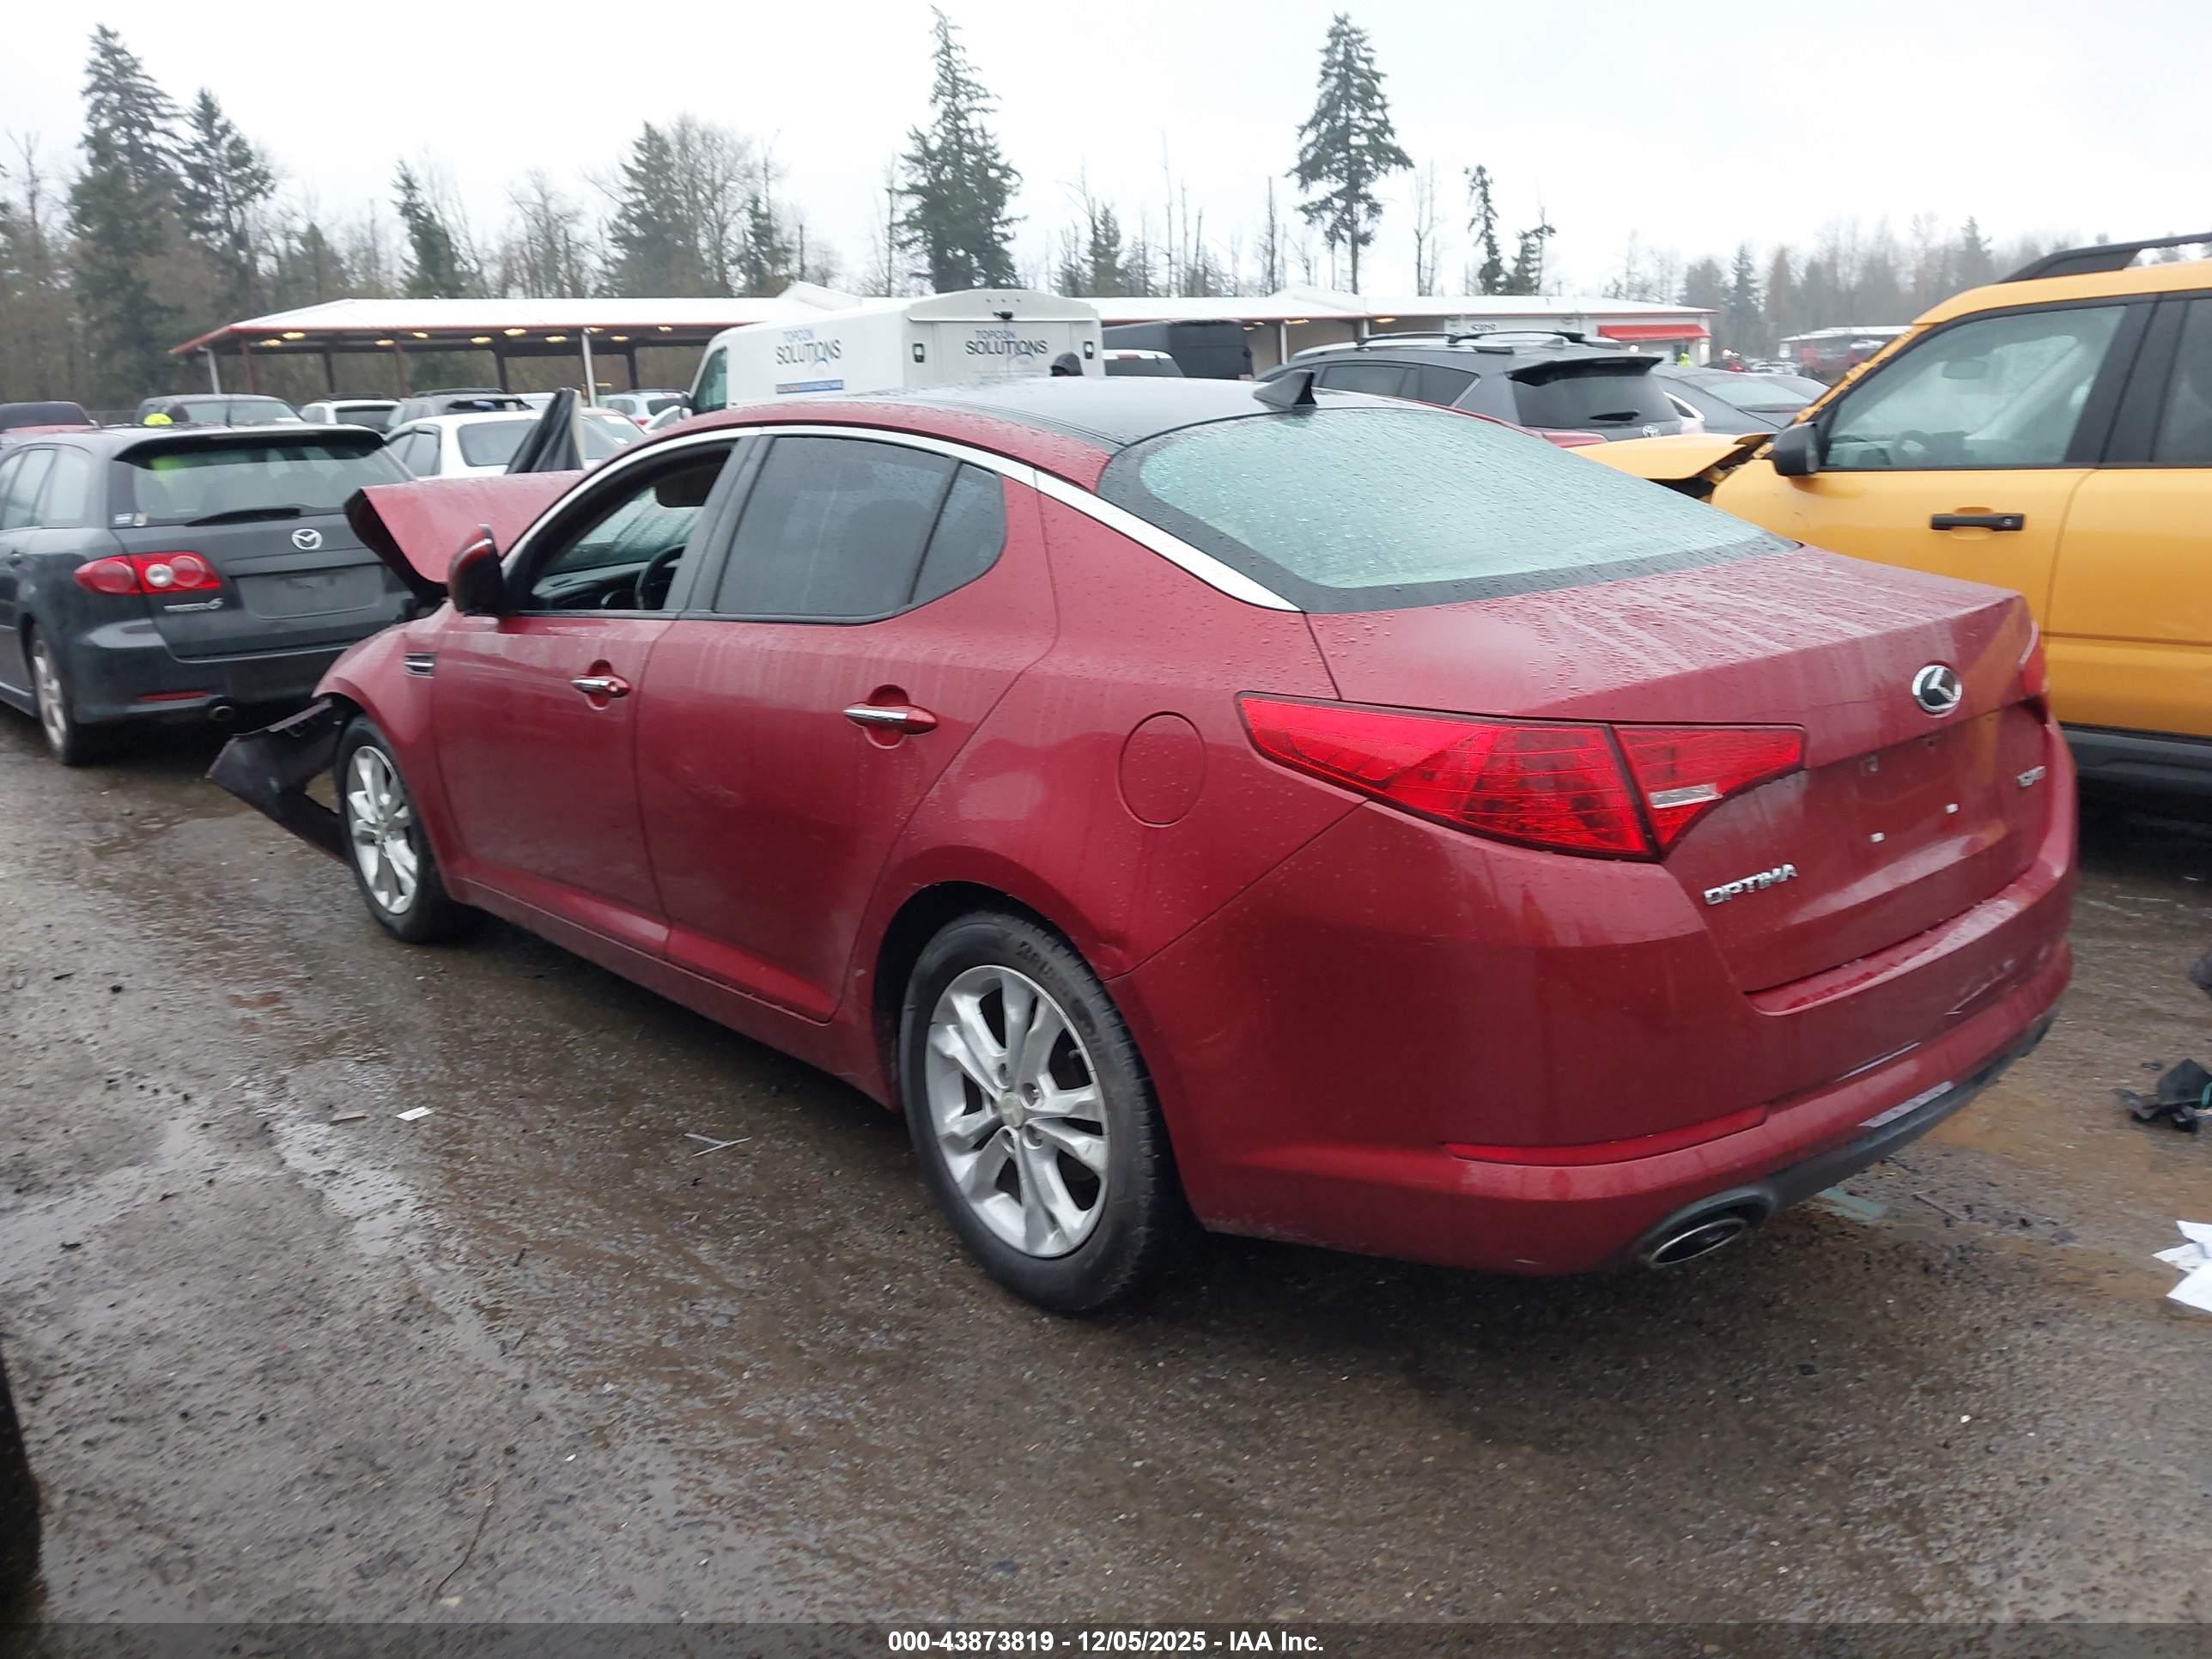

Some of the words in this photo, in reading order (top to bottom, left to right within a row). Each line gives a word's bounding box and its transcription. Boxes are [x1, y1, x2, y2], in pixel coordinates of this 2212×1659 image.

[776, 339, 842, 364] SOLUTIONS
[965, 340, 1048, 355] SOLUTIONS
[1704, 864, 1798, 904] OPTIMA
